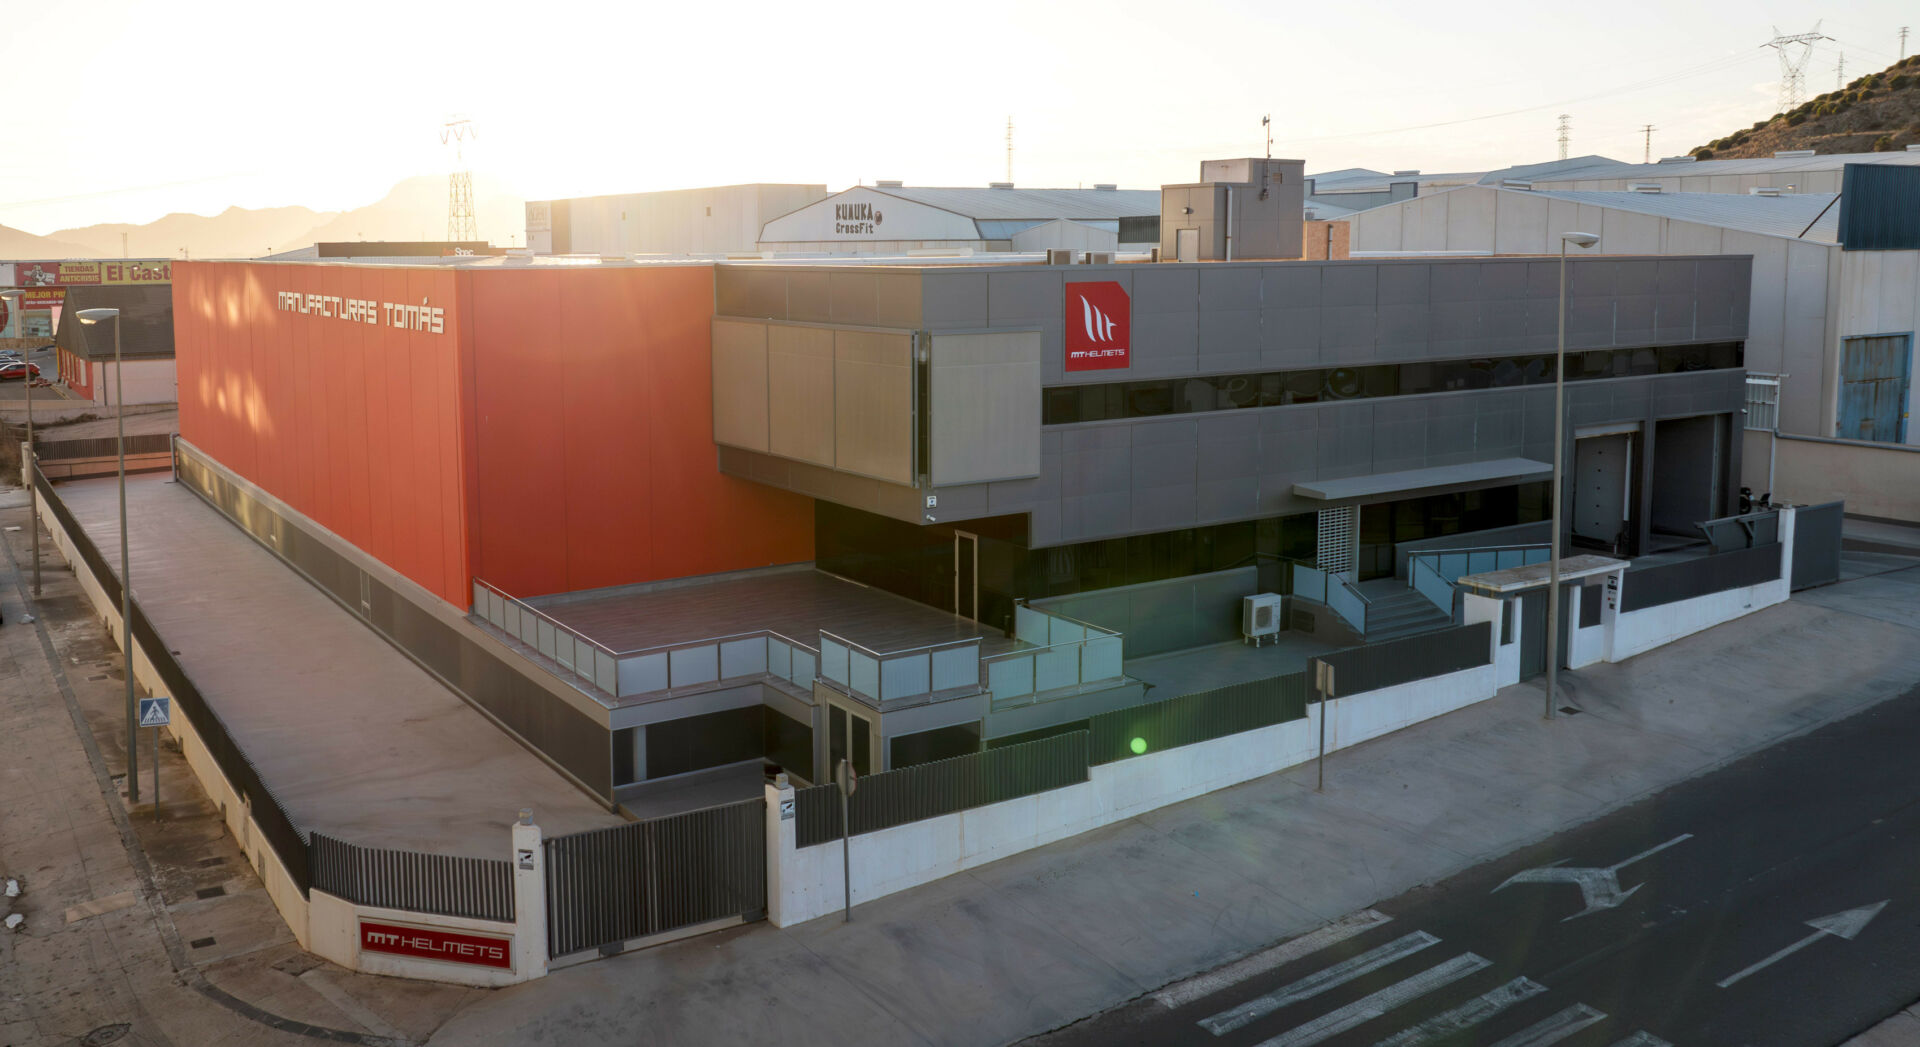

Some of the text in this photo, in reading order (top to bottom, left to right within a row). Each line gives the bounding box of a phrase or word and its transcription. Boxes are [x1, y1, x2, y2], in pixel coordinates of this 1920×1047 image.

[836, 222, 874, 234] CrossFit
[64, 265, 94, 273] TIENDAS
[107, 265, 123, 281] El
[278, 291, 444, 334] MANUFACTURAS TOMÁS
